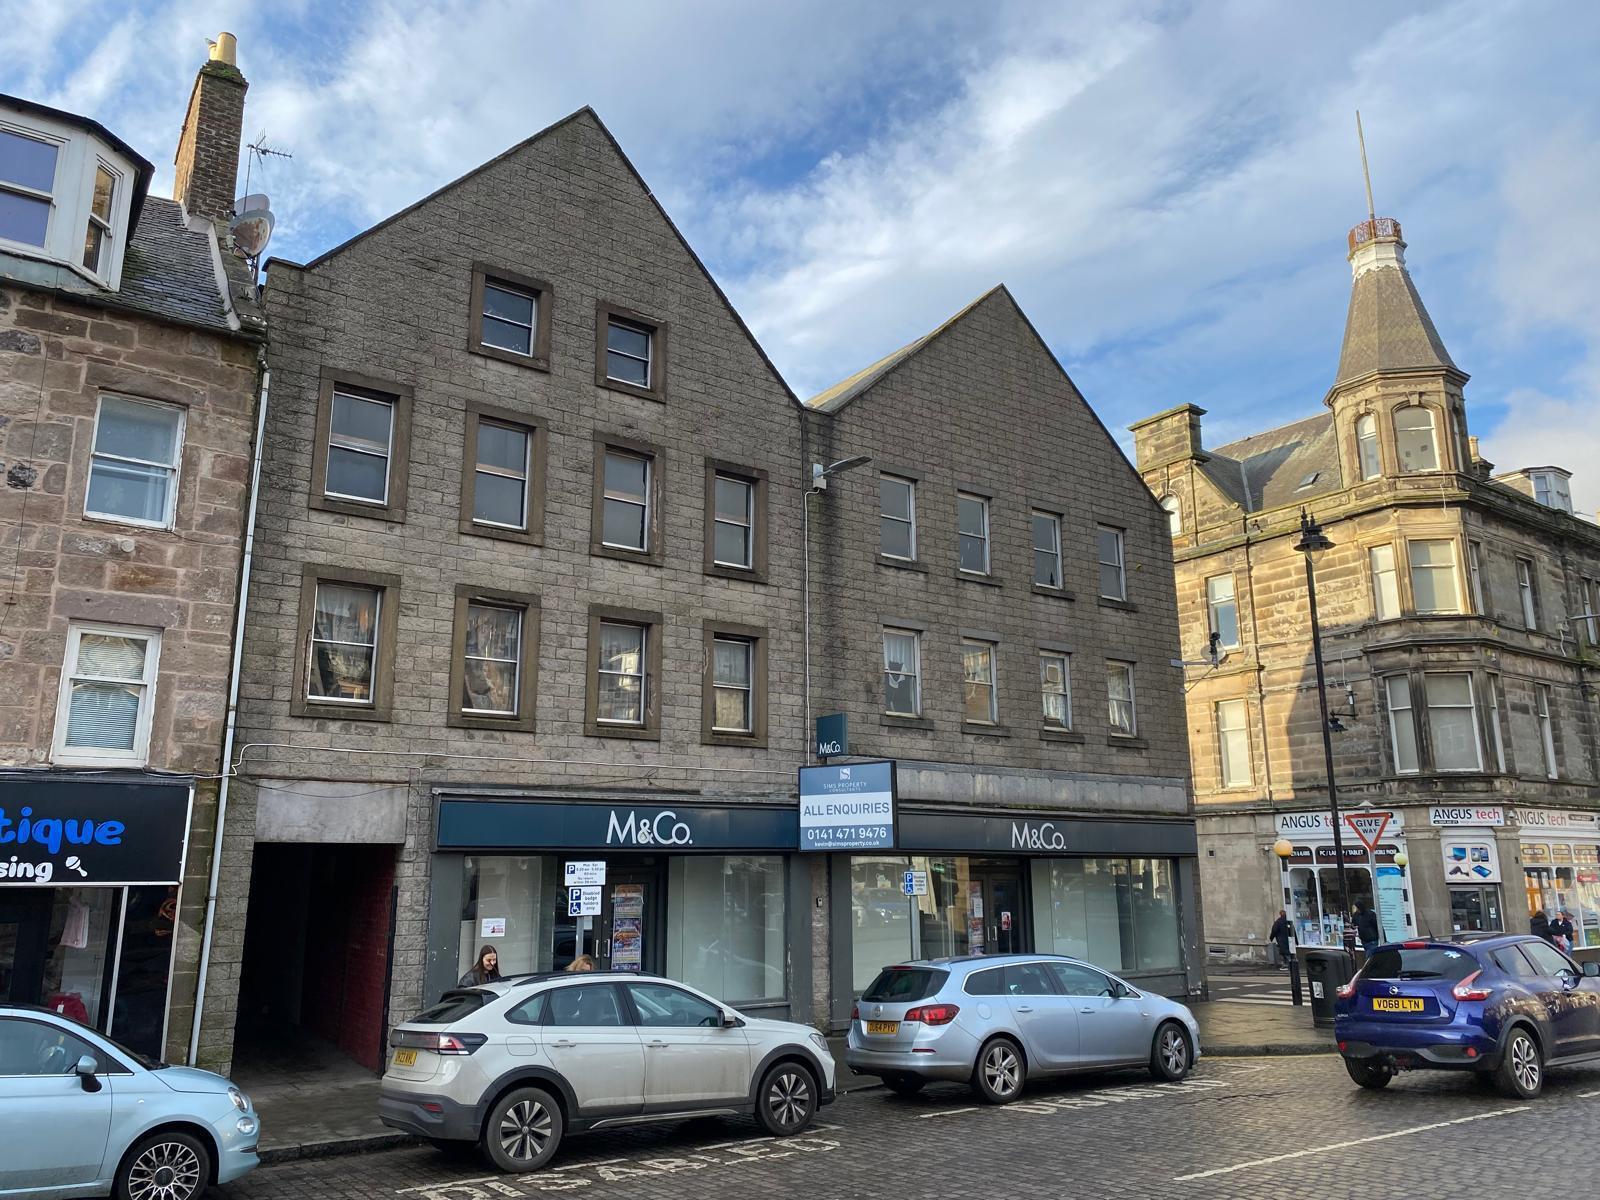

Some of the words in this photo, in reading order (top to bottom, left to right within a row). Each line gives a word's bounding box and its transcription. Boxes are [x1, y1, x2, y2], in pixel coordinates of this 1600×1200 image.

[837, 781, 867, 789] PROPERTY
[803, 805, 824, 817] ALL
[826, 802, 890, 816] ENQUIRIES
[1433, 808, 1472, 820] ANGUS
[1476, 808, 1500, 820] tech
[1281, 815, 1321, 829] ANGUS
[1356, 819, 1380, 827] GIVE
[1515, 811, 1545, 825] ANGUS
[1547, 813, 1566, 826] tech
[606, 810, 693, 845] M&Co.
[807, 829, 833, 840] 0141
[836, 828, 856, 839] 471
[858, 827, 887, 839] 9476
[1011, 821, 1067, 850] M&Co.
[1377, 999, 1400, 1009] VO68
[1402, 999, 1420, 1009] LTN
